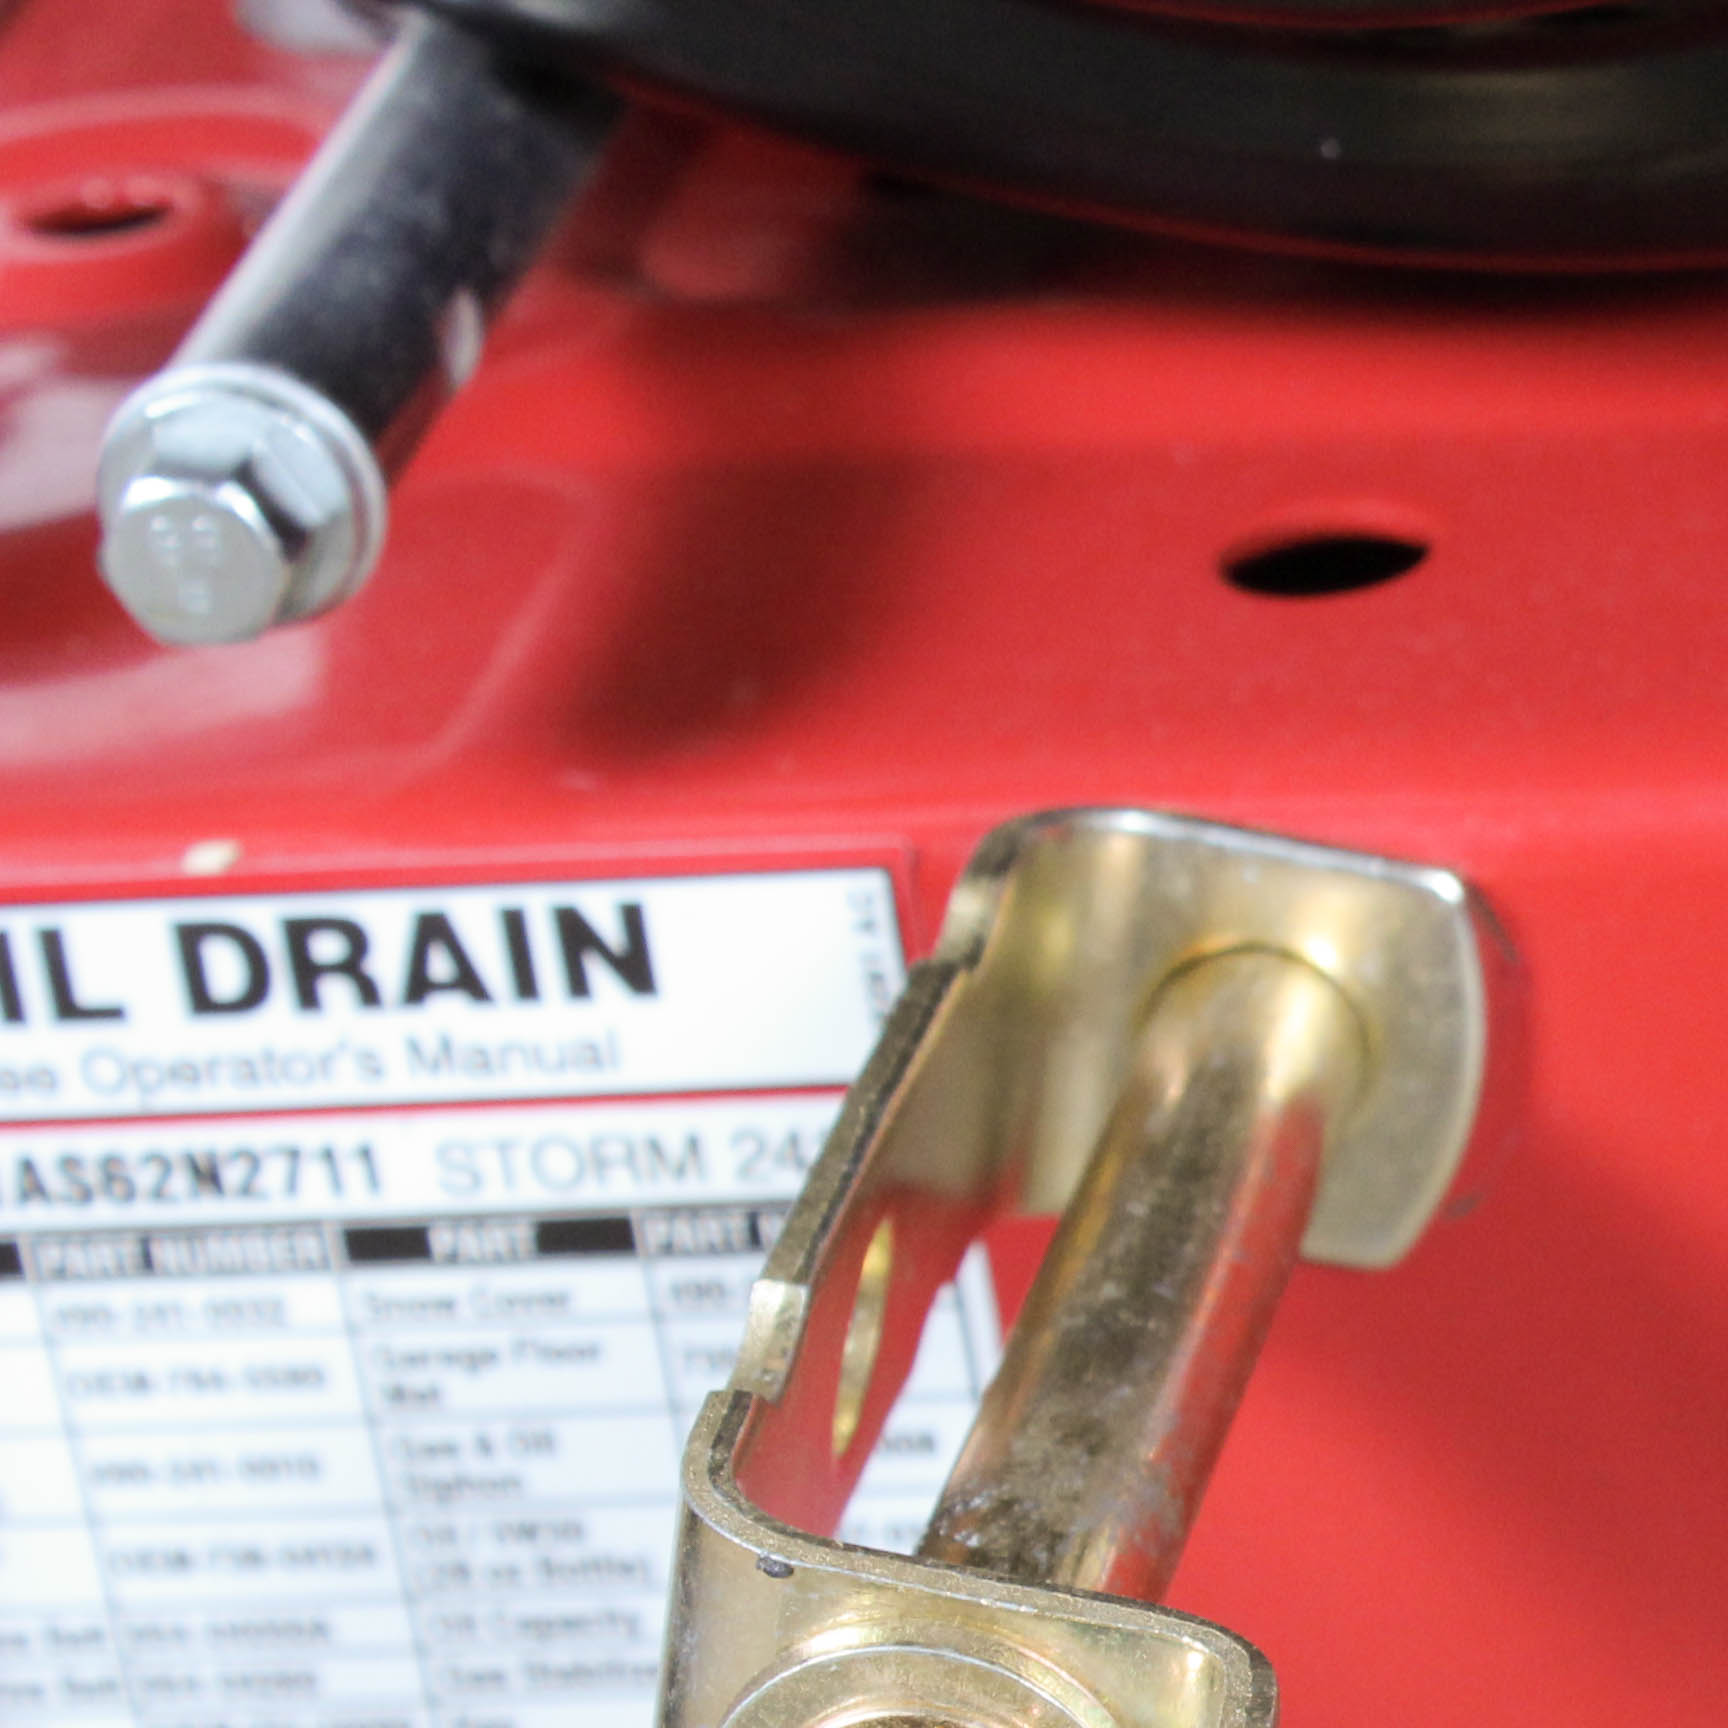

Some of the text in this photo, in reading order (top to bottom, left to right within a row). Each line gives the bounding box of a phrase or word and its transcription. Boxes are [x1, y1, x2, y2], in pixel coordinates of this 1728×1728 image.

[172, 901, 660, 1018] DRAIN
[80, 1036, 385, 1112] Operator's
[408, 1027, 623, 1084] Manual
[434, 1130, 710, 1197] STORM
[728, 1126, 830, 1184] 24
[38, 1228, 329, 1280] PART NUMBER
[432, 1223, 532, 1264] PART
[645, 1211, 750, 1256] PART
